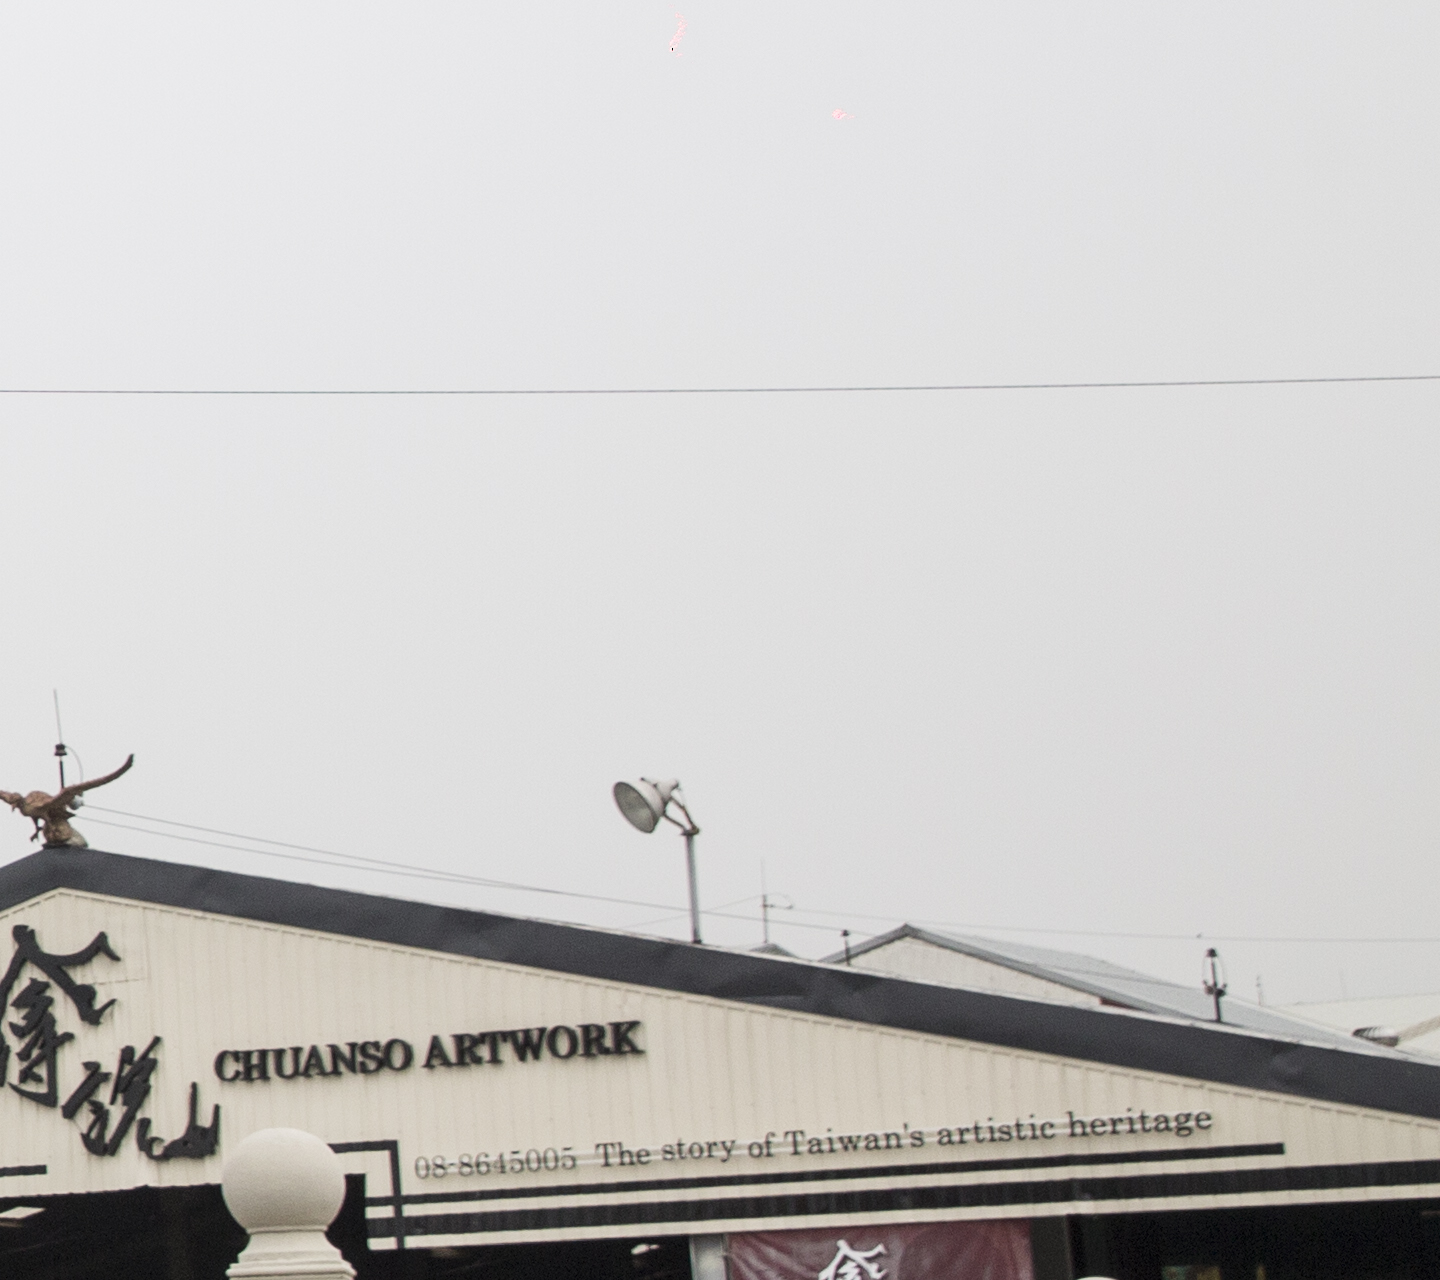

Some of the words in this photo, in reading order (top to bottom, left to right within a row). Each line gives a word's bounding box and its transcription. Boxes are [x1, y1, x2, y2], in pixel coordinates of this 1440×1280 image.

[213, 1038, 414, 1084] CHUANSO
[421, 1020, 645, 1070] ARTWORK
[414, 1146, 578, 1180] 08-8645005
[594, 1141, 651, 1168] The
[661, 1137, 736, 1164] story
[747, 1131, 776, 1159] of
[782, 1121, 926, 1157] Taiwan's
[936, 1111, 1057, 1145] artistic
[1066, 1107, 1213, 1138] heritage
